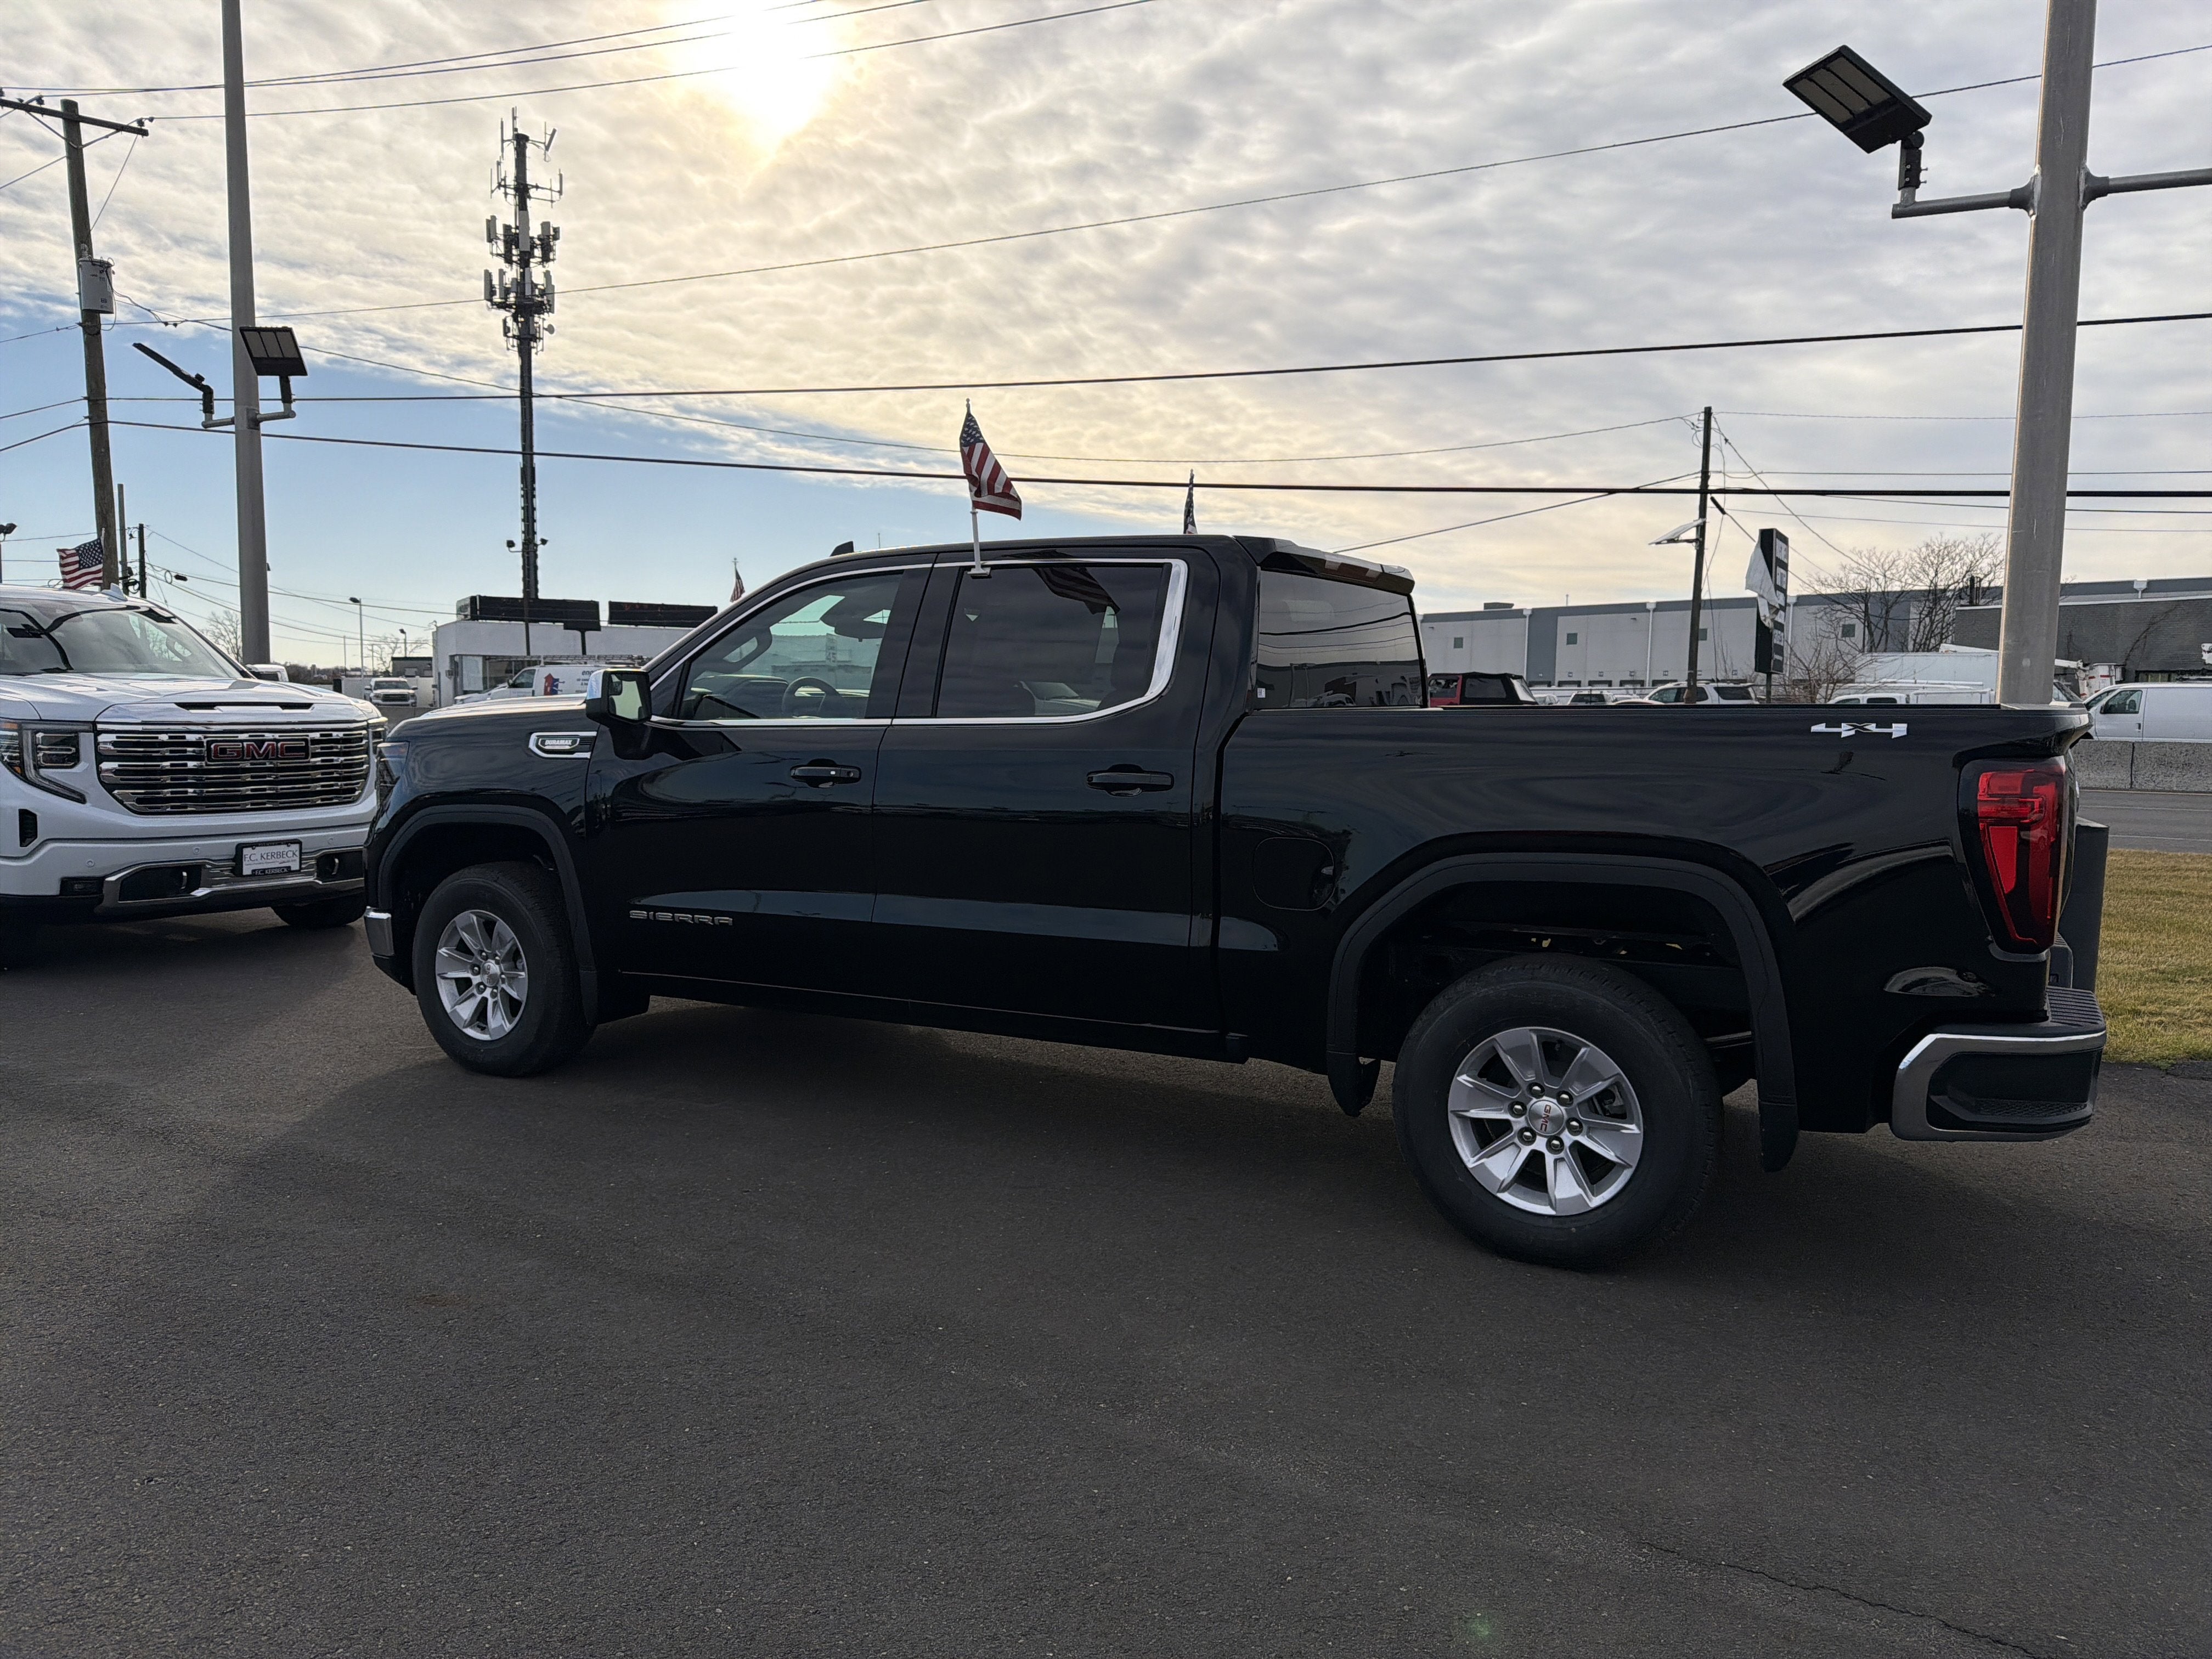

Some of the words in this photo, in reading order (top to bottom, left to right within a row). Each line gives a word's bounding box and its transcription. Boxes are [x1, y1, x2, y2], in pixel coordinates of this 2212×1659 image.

[211, 741, 306, 759] GMC
[244, 854, 258, 862] F.C.
[260, 850, 298, 860] KERBECK
[629, 910, 733, 926] SIERRA
[1540, 1104, 1551, 1132] GMC
